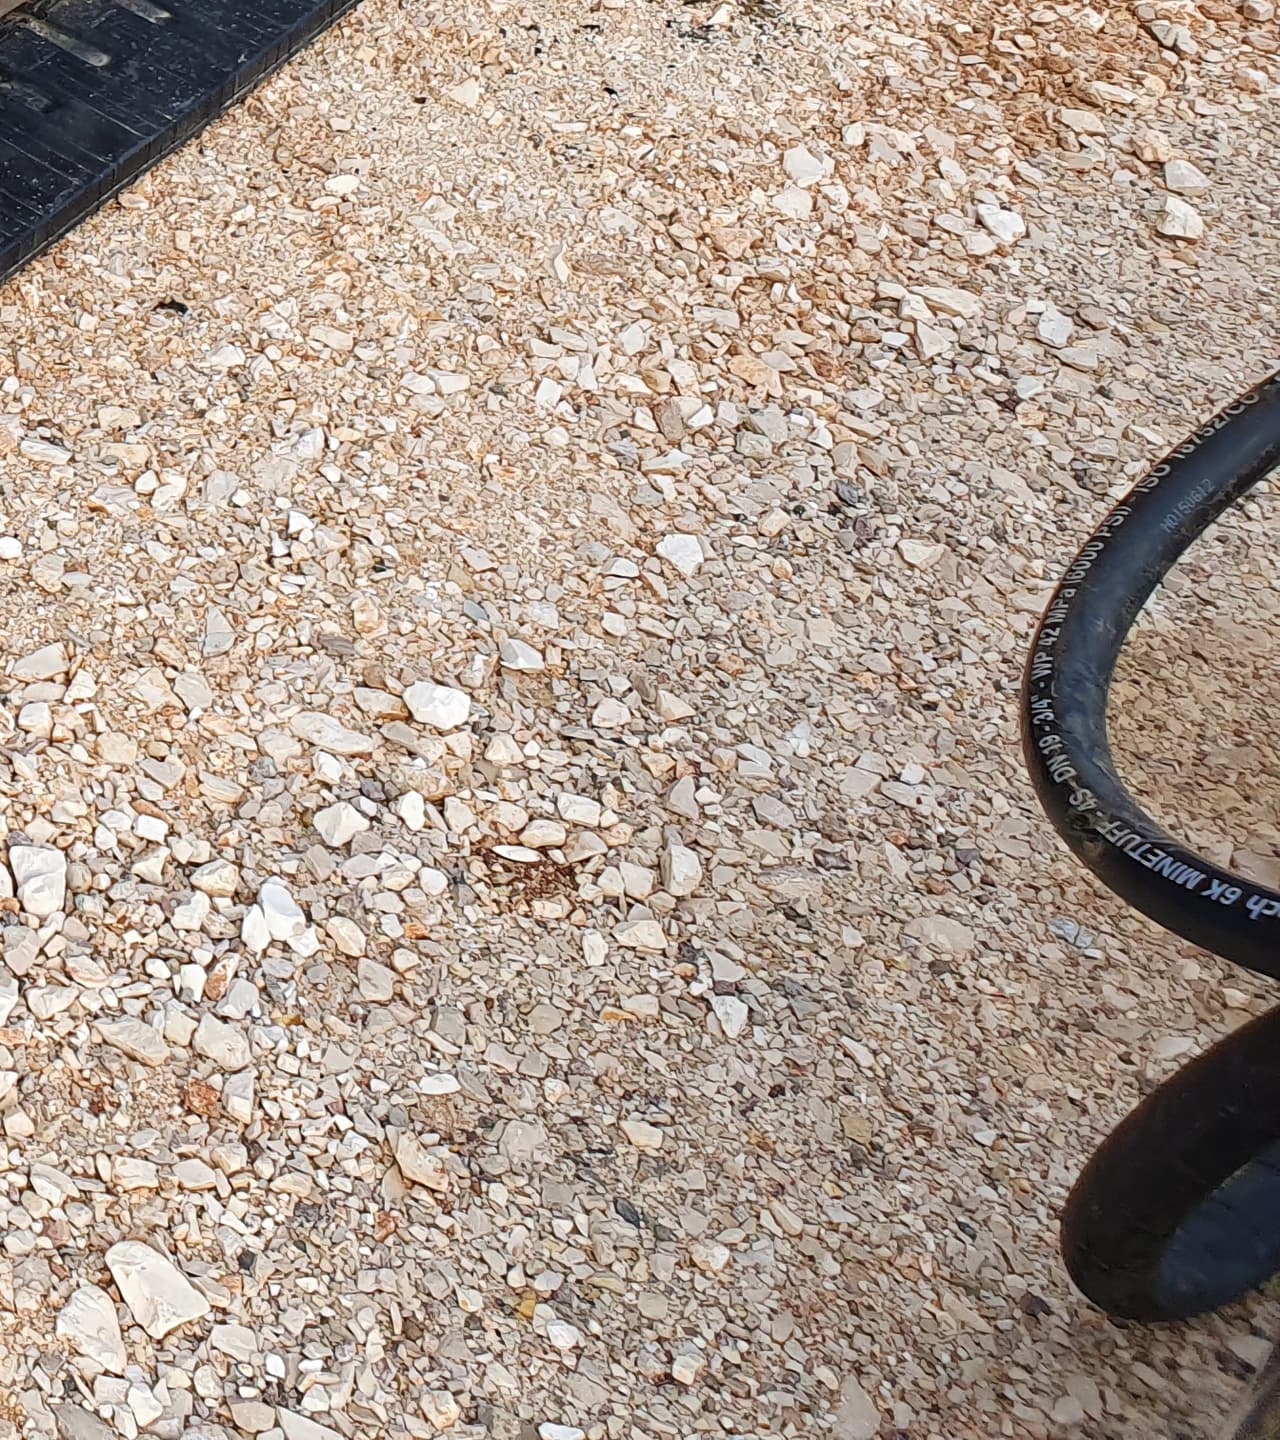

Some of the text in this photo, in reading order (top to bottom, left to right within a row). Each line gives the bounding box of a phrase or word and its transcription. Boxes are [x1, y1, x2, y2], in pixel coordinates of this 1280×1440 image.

[1135, 463, 1171, 494] ISO
[1067, 540, 1104, 584] (6000
[1043, 586, 1078, 625] MPa
[1038, 627, 1061, 646] 42
[1031, 651, 1054, 681] WP
[1038, 734, 1064, 755] 19
[1046, 754, 1078, 784] DN
[1069, 788, 1098, 811] 4S
[1095, 820, 1208, 890] MINETUFF
[1201, 878, 1242, 906] 6K
